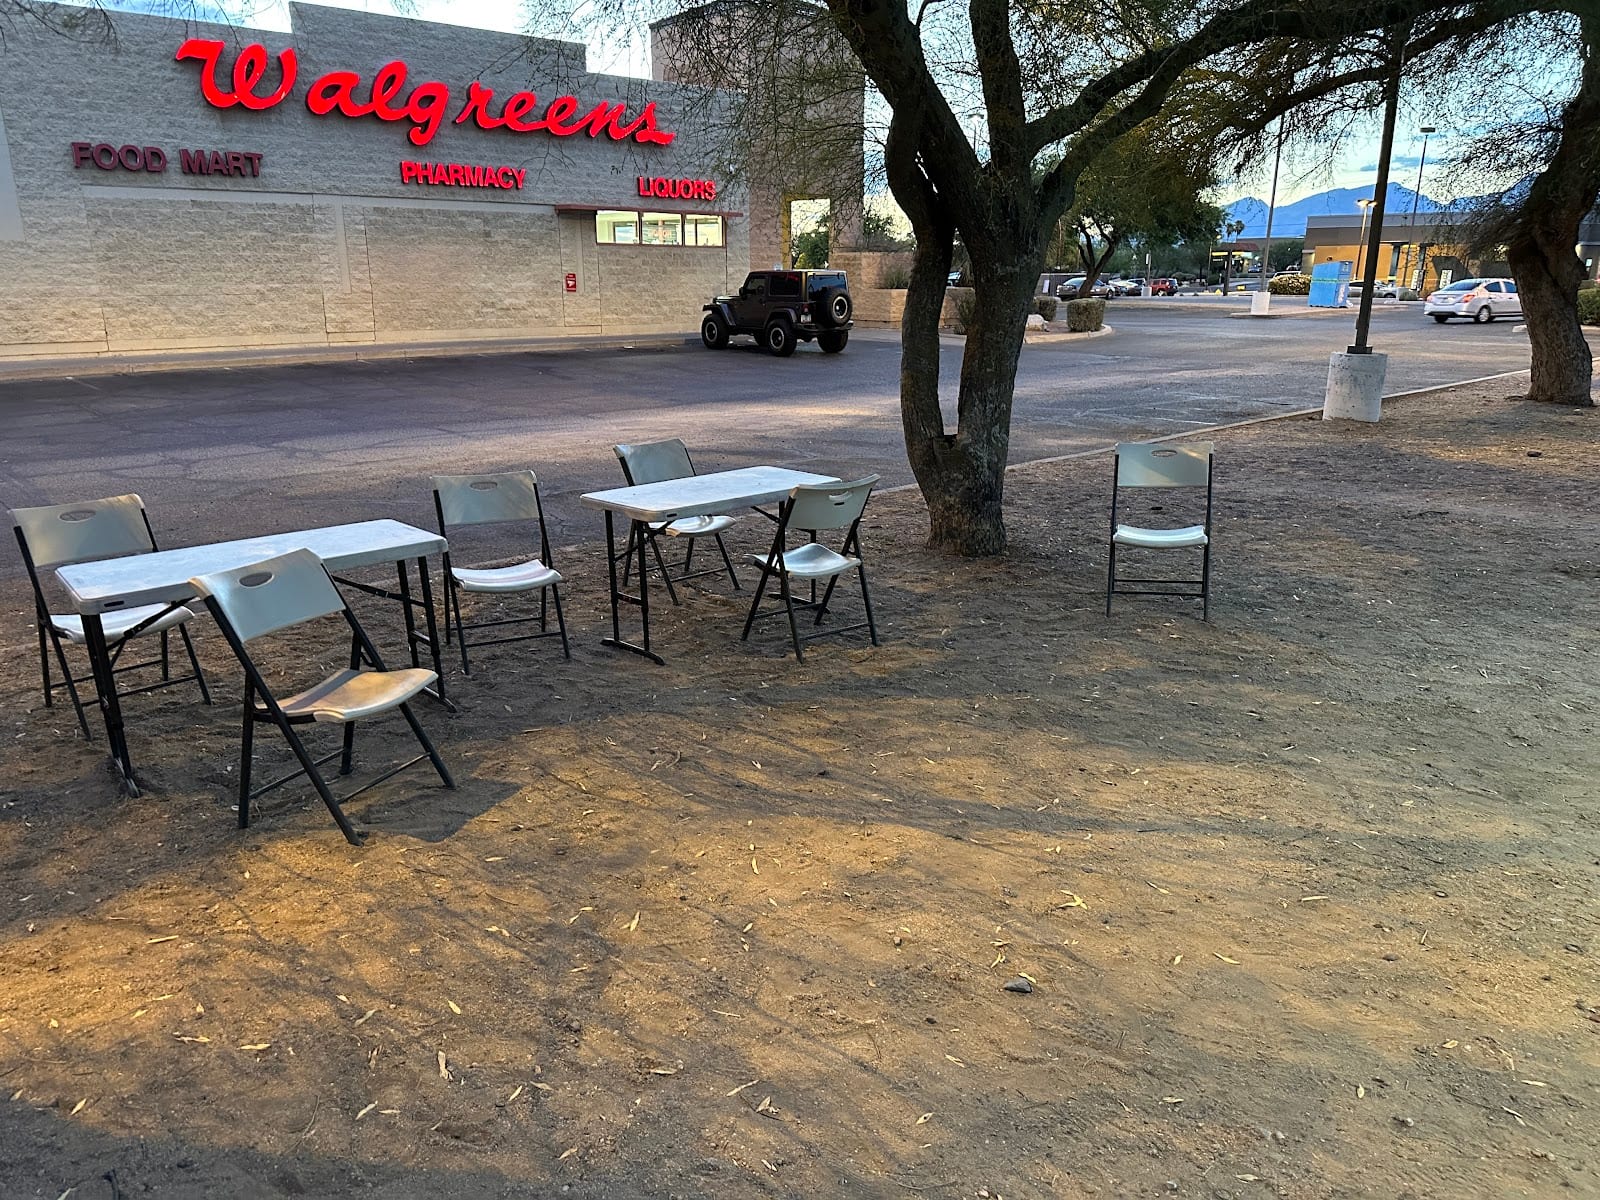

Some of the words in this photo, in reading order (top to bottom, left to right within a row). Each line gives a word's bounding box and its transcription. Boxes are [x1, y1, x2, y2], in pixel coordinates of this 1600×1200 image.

[176, 39, 676, 147] Walgreens
[71, 142, 168, 173] FOOD
[179, 149, 264, 177] MART
[401, 160, 527, 190] PHARMACY
[638, 175, 717, 201] LIQUORS
